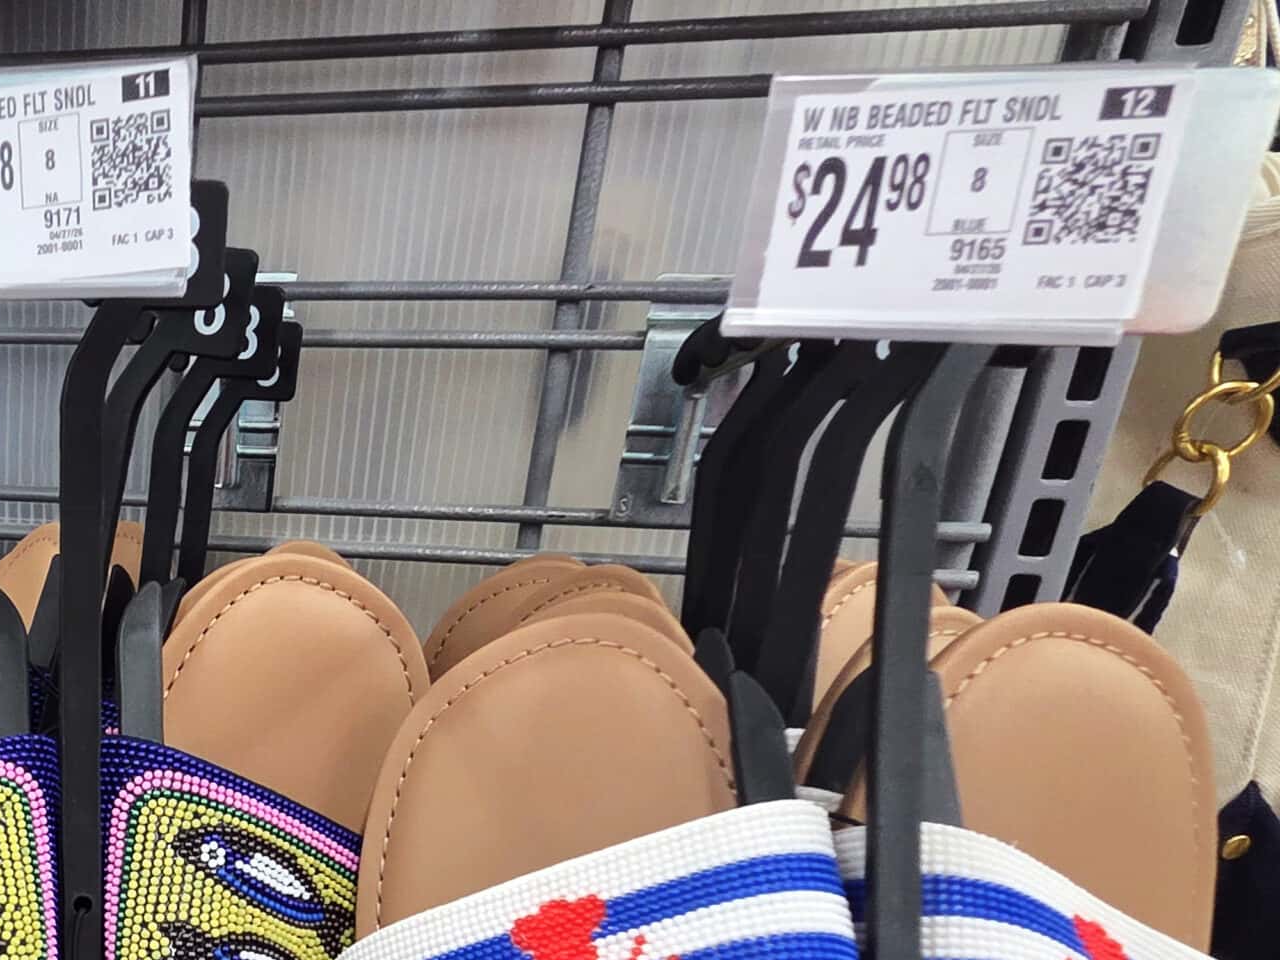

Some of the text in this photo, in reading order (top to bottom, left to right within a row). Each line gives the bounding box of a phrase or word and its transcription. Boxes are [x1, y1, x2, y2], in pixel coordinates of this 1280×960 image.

[135, 73, 156, 98] 11
[23, 91, 48, 117] FLT
[54, 84, 96, 112] SNDL
[1119, 88, 1158, 118] 12
[803, 94, 1062, 133] W NB BEADED FLT SNDL
[38, 119, 59, 133] SIZE
[798, 134, 886, 151] RETAIL PRICE
[44, 149, 55, 171] 8
[970, 167, 988, 193] 8
[45, 191, 58, 204] NA
[43, 206, 82, 230] 9171
[111, 233, 131, 247] FAC
[145, 229, 165, 242] CAP
[949, 237, 1007, 262] 9165
